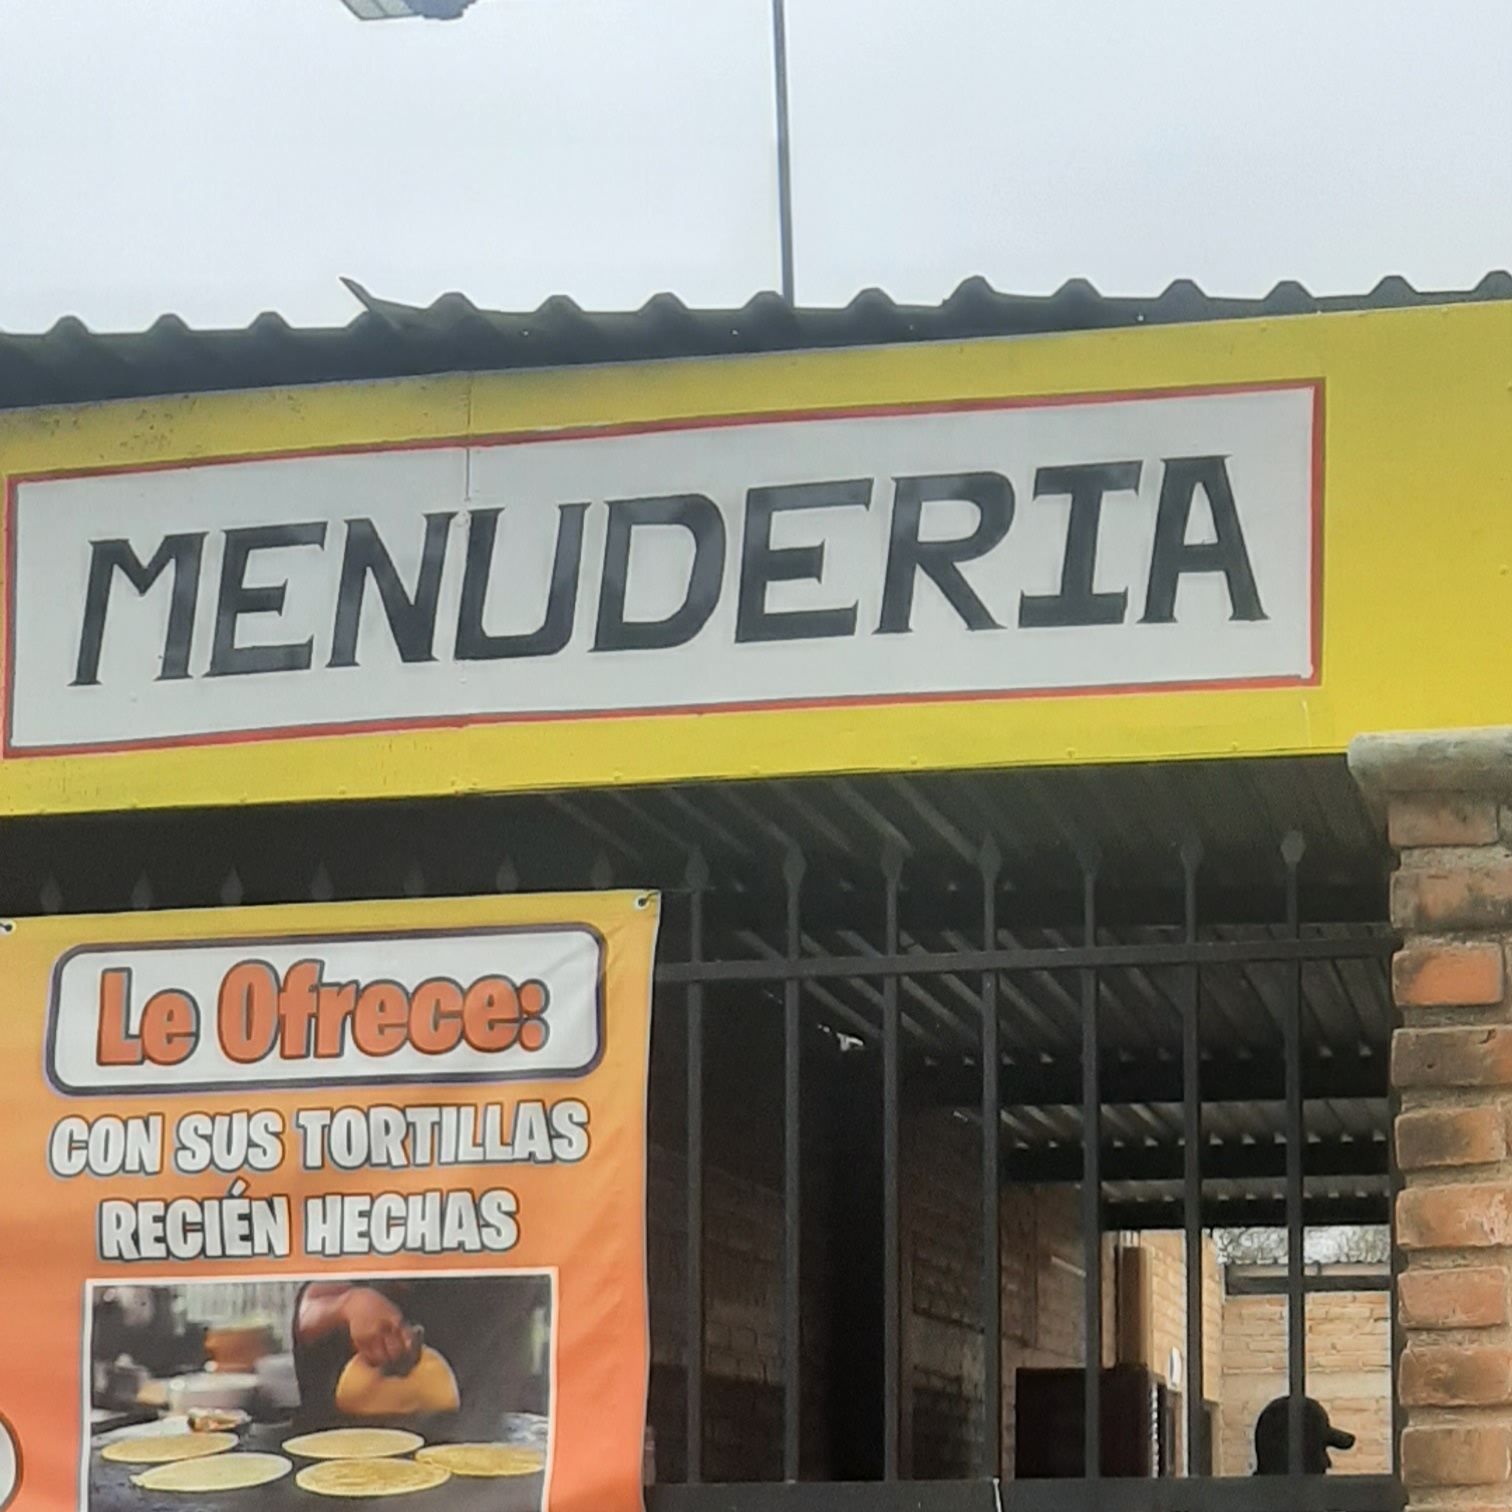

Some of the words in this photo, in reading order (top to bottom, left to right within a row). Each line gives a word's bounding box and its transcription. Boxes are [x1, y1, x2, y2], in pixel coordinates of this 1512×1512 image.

[68, 455, 1269, 686] MENUDERIA
[96, 967, 200, 1067] Le
[217, 959, 551, 1065] Ofrece:
[48, 1113, 164, 1179] CON
[172, 1110, 284, 1173] SUS
[297, 1098, 590, 1170] TORTILLAS
[98, 1178, 290, 1262] RECIÉN
[304, 1189, 519, 1257] HECHAS
